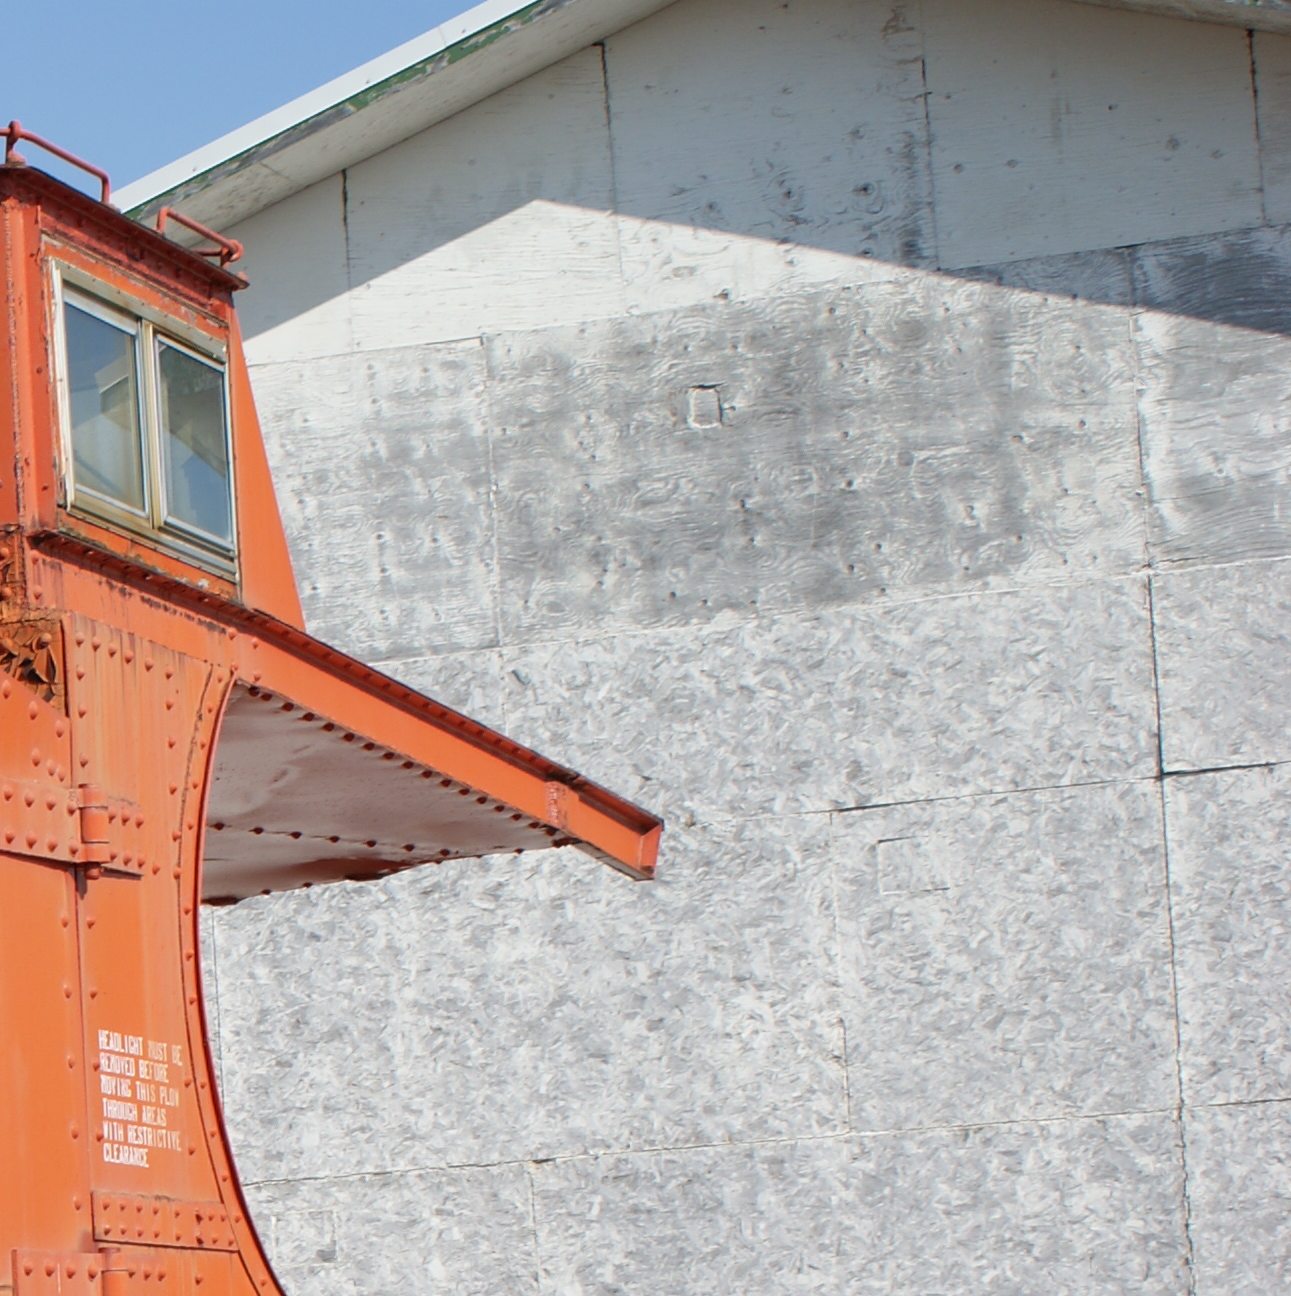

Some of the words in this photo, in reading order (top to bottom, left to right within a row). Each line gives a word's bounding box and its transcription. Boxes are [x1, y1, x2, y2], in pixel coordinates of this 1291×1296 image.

[98, 1029, 143, 1056] HEADLIGHT
[148, 1040, 167, 1062] MUST
[172, 1045, 182, 1066] BE
[99, 1052, 135, 1077] REMOVED
[139, 1059, 169, 1083] BEFORE
[100, 1075, 131, 1098] MOVING
[136, 1081, 156, 1103] THIS
[102, 1098, 138, 1122] THROUGH
[142, 1105, 167, 1127] AREAS
[103, 1121, 124, 1142] WITH
[127, 1124, 182, 1151] RESTRICTIVE
[103, 1143, 149, 1168] CLEARANCE
